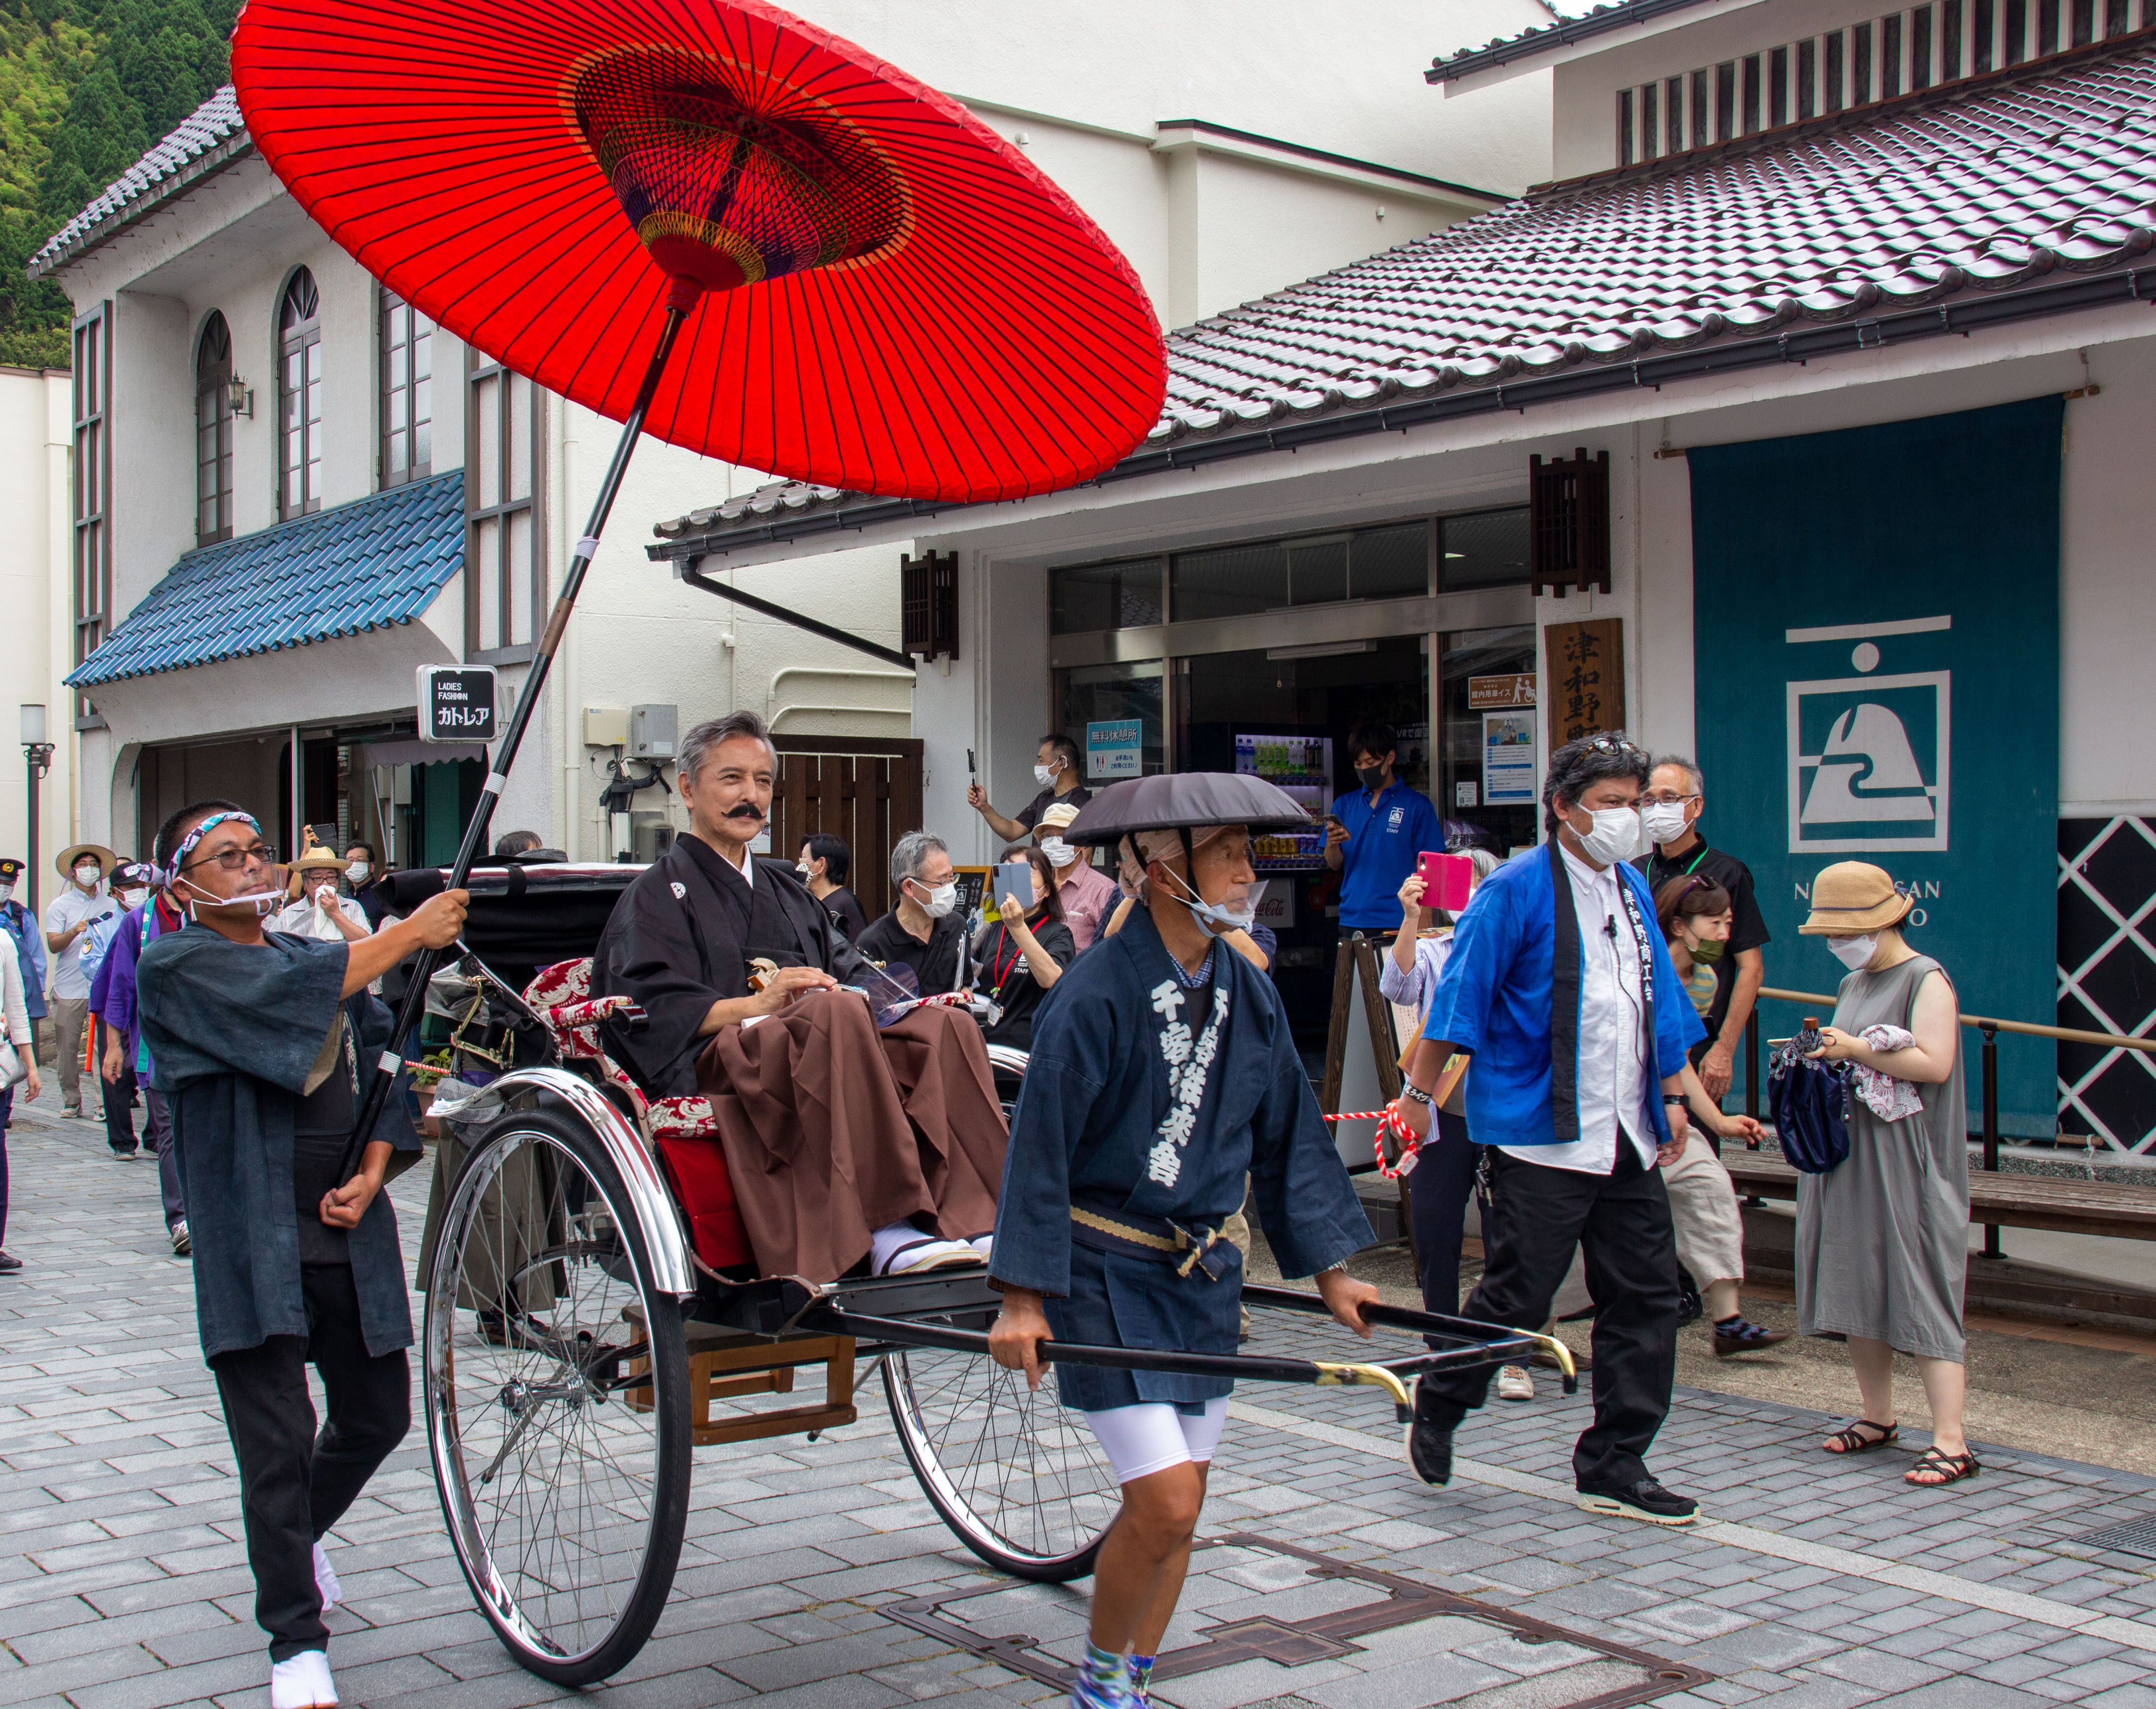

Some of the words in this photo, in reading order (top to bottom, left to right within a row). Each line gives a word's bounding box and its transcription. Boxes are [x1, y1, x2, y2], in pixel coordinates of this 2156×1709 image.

[438, 682, 462, 691] LADIES
[438, 692, 468, 701] FASHION
[438, 707, 490, 726] カトレア
[1091, 728, 1137, 744] 無料休憩所
